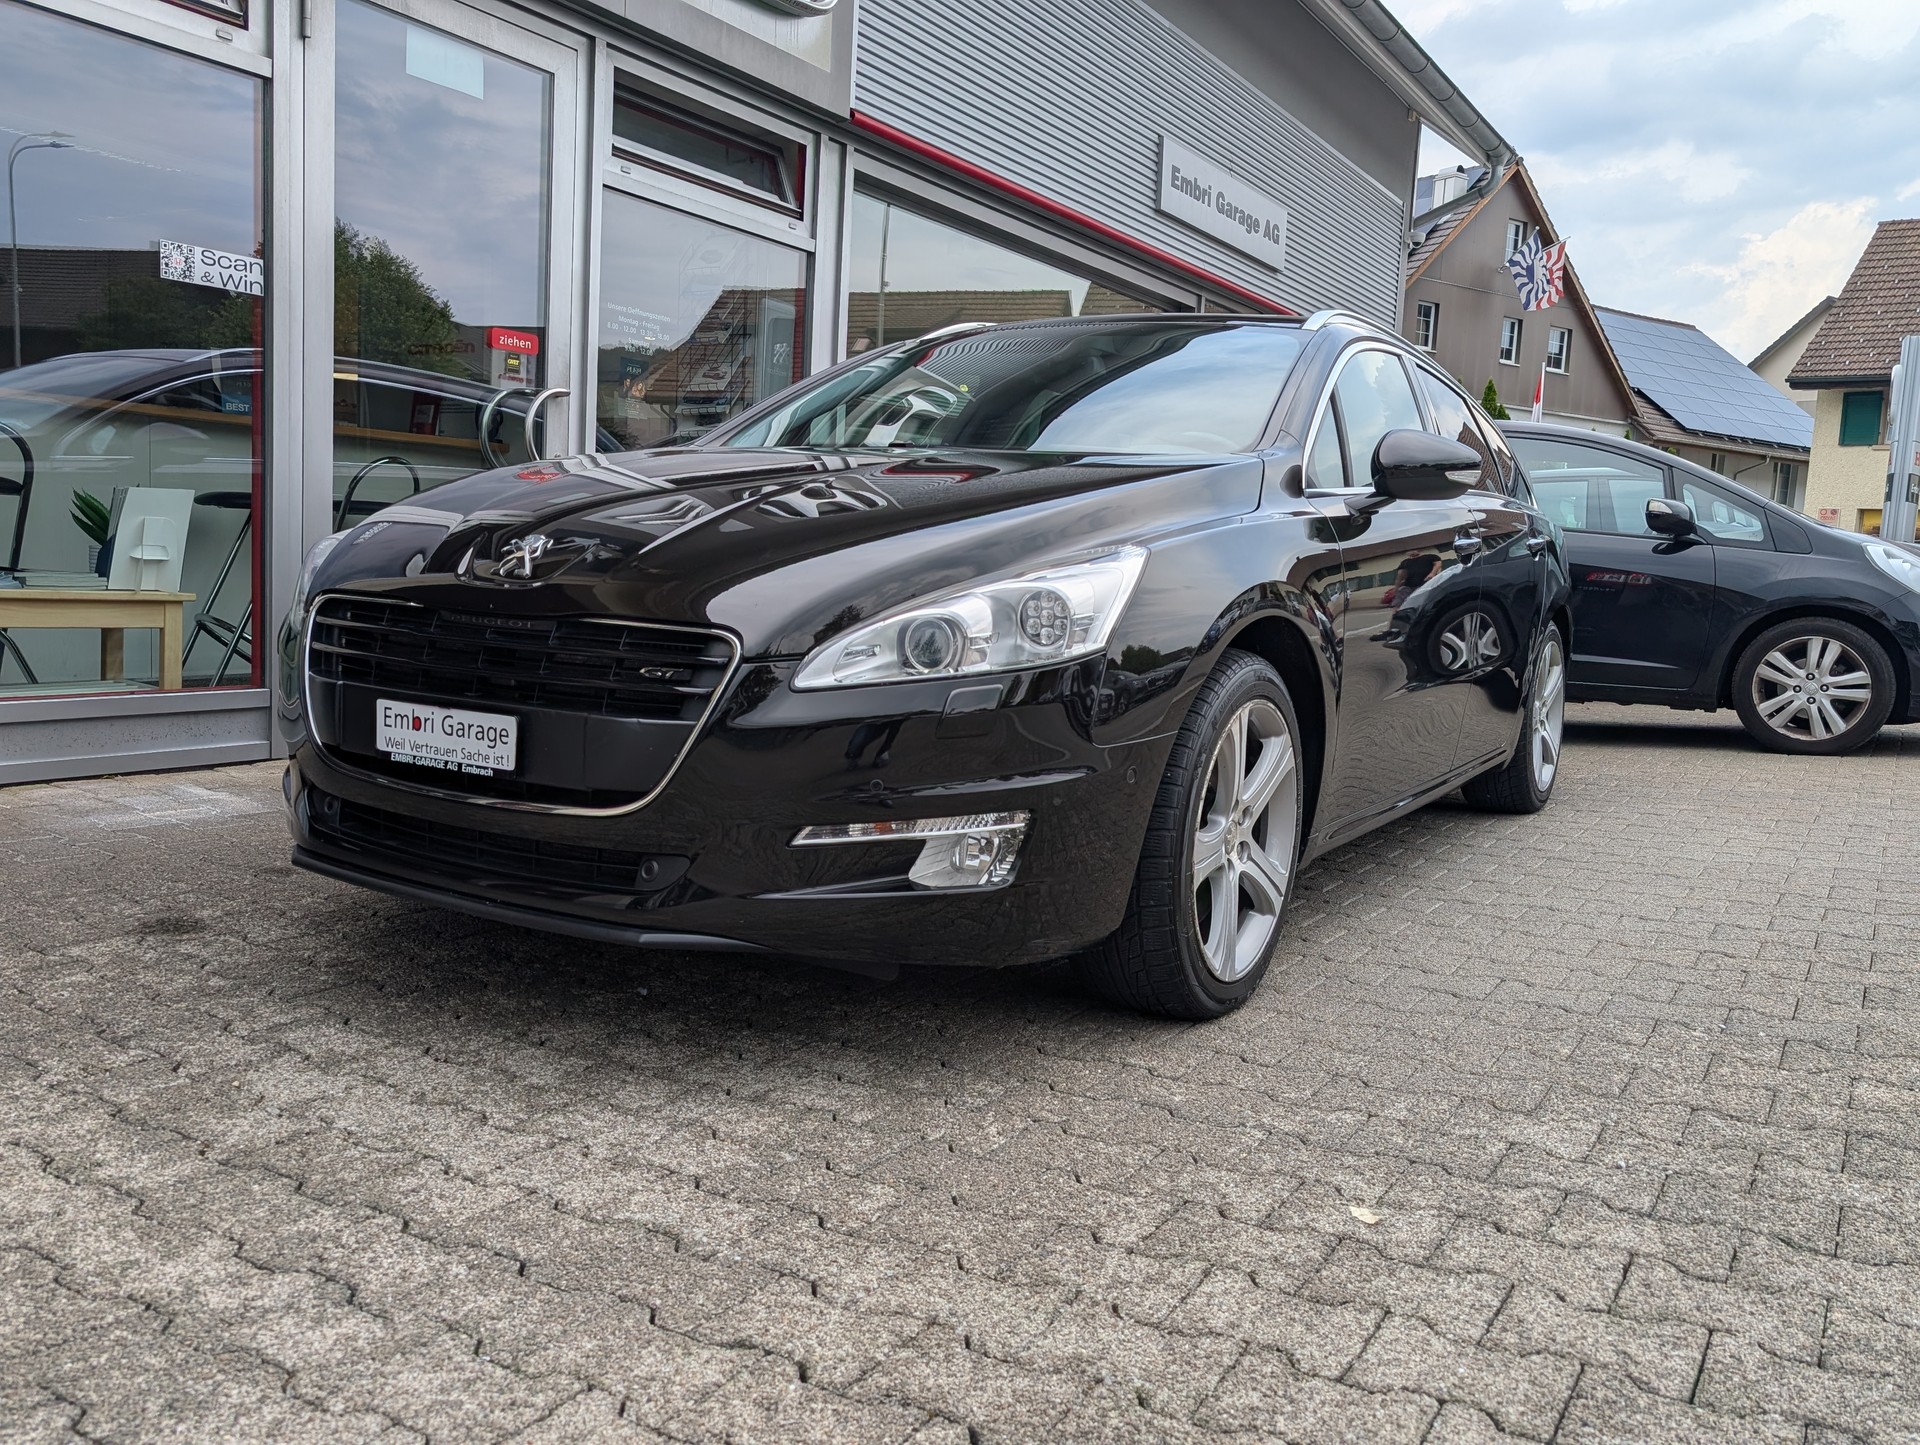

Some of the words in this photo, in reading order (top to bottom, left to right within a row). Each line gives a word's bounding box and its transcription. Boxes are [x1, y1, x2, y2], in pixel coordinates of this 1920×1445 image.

[1170, 164, 1212, 208] Embri
[1215, 191, 1260, 235] Garage
[1263, 219, 1280, 246] AG
[200, 249, 263, 276] Scan
[200, 271, 215, 284] &
[219, 271, 263, 295] Win
[607, 302, 627, 312] Unsere
[618, 315, 639, 327] Montag
[643, 320, 660, 331] Freitag
[623, 325, 637, 334] 12.00
[499, 335, 532, 349] ziehen
[225, 402, 250, 412] BEST
[451, 614, 535, 629] PEUGEOT
[383, 706, 435, 734] Embri
[441, 715, 510, 749] Garage
[384, 736, 406, 751] Weil
[408, 738, 458, 759] Vertrauen
[460, 747, 491, 764] Sache
[390, 752, 446, 770] EMBRI-GARAGE
[446, 761, 459, 771] AG
[461, 763, 494, 777] Embrach
